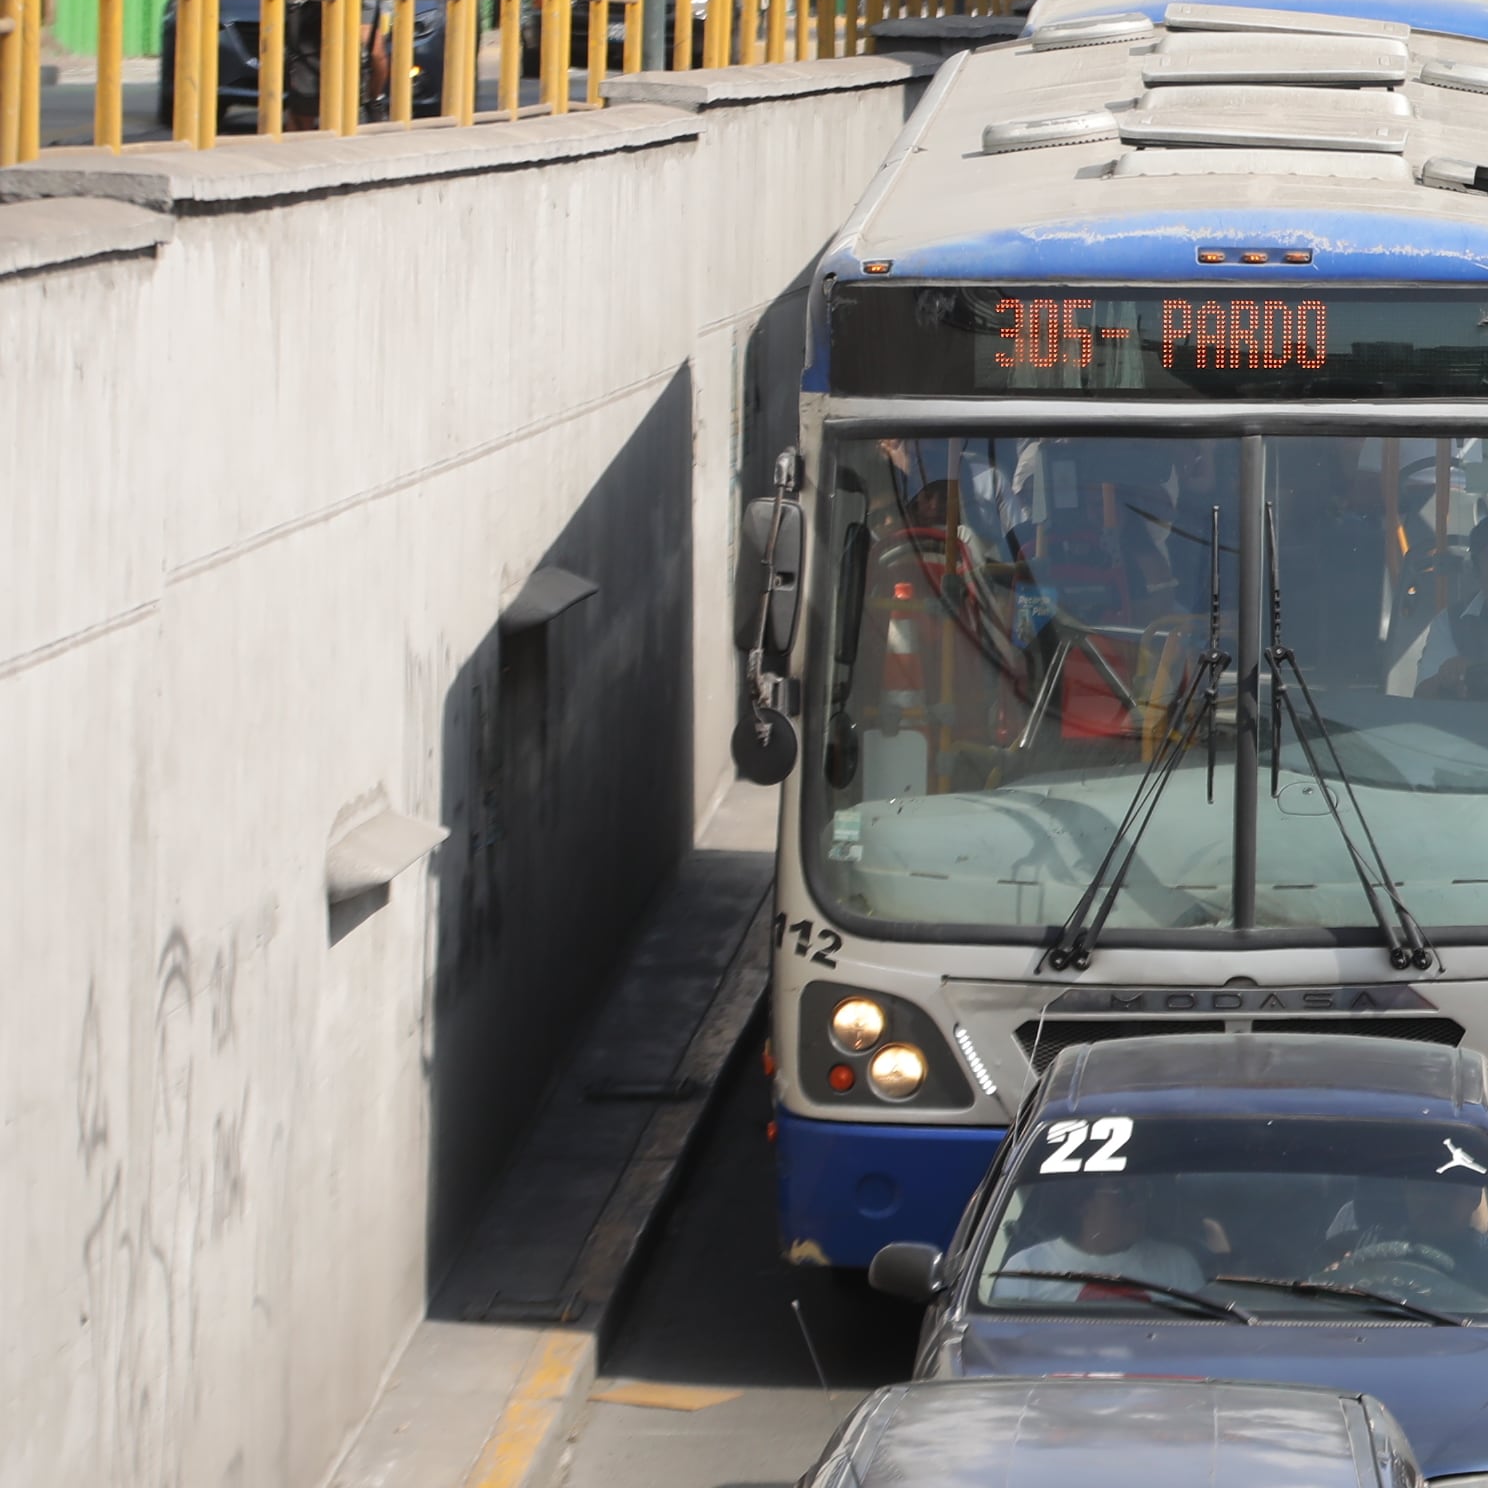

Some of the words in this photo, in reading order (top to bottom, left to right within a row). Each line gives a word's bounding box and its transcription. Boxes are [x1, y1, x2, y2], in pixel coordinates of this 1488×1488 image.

[1163, 299, 1327, 369] PARDO
[1109, 990, 1380, 1010] MODASA
[1039, 1116, 1134, 1174] 22
